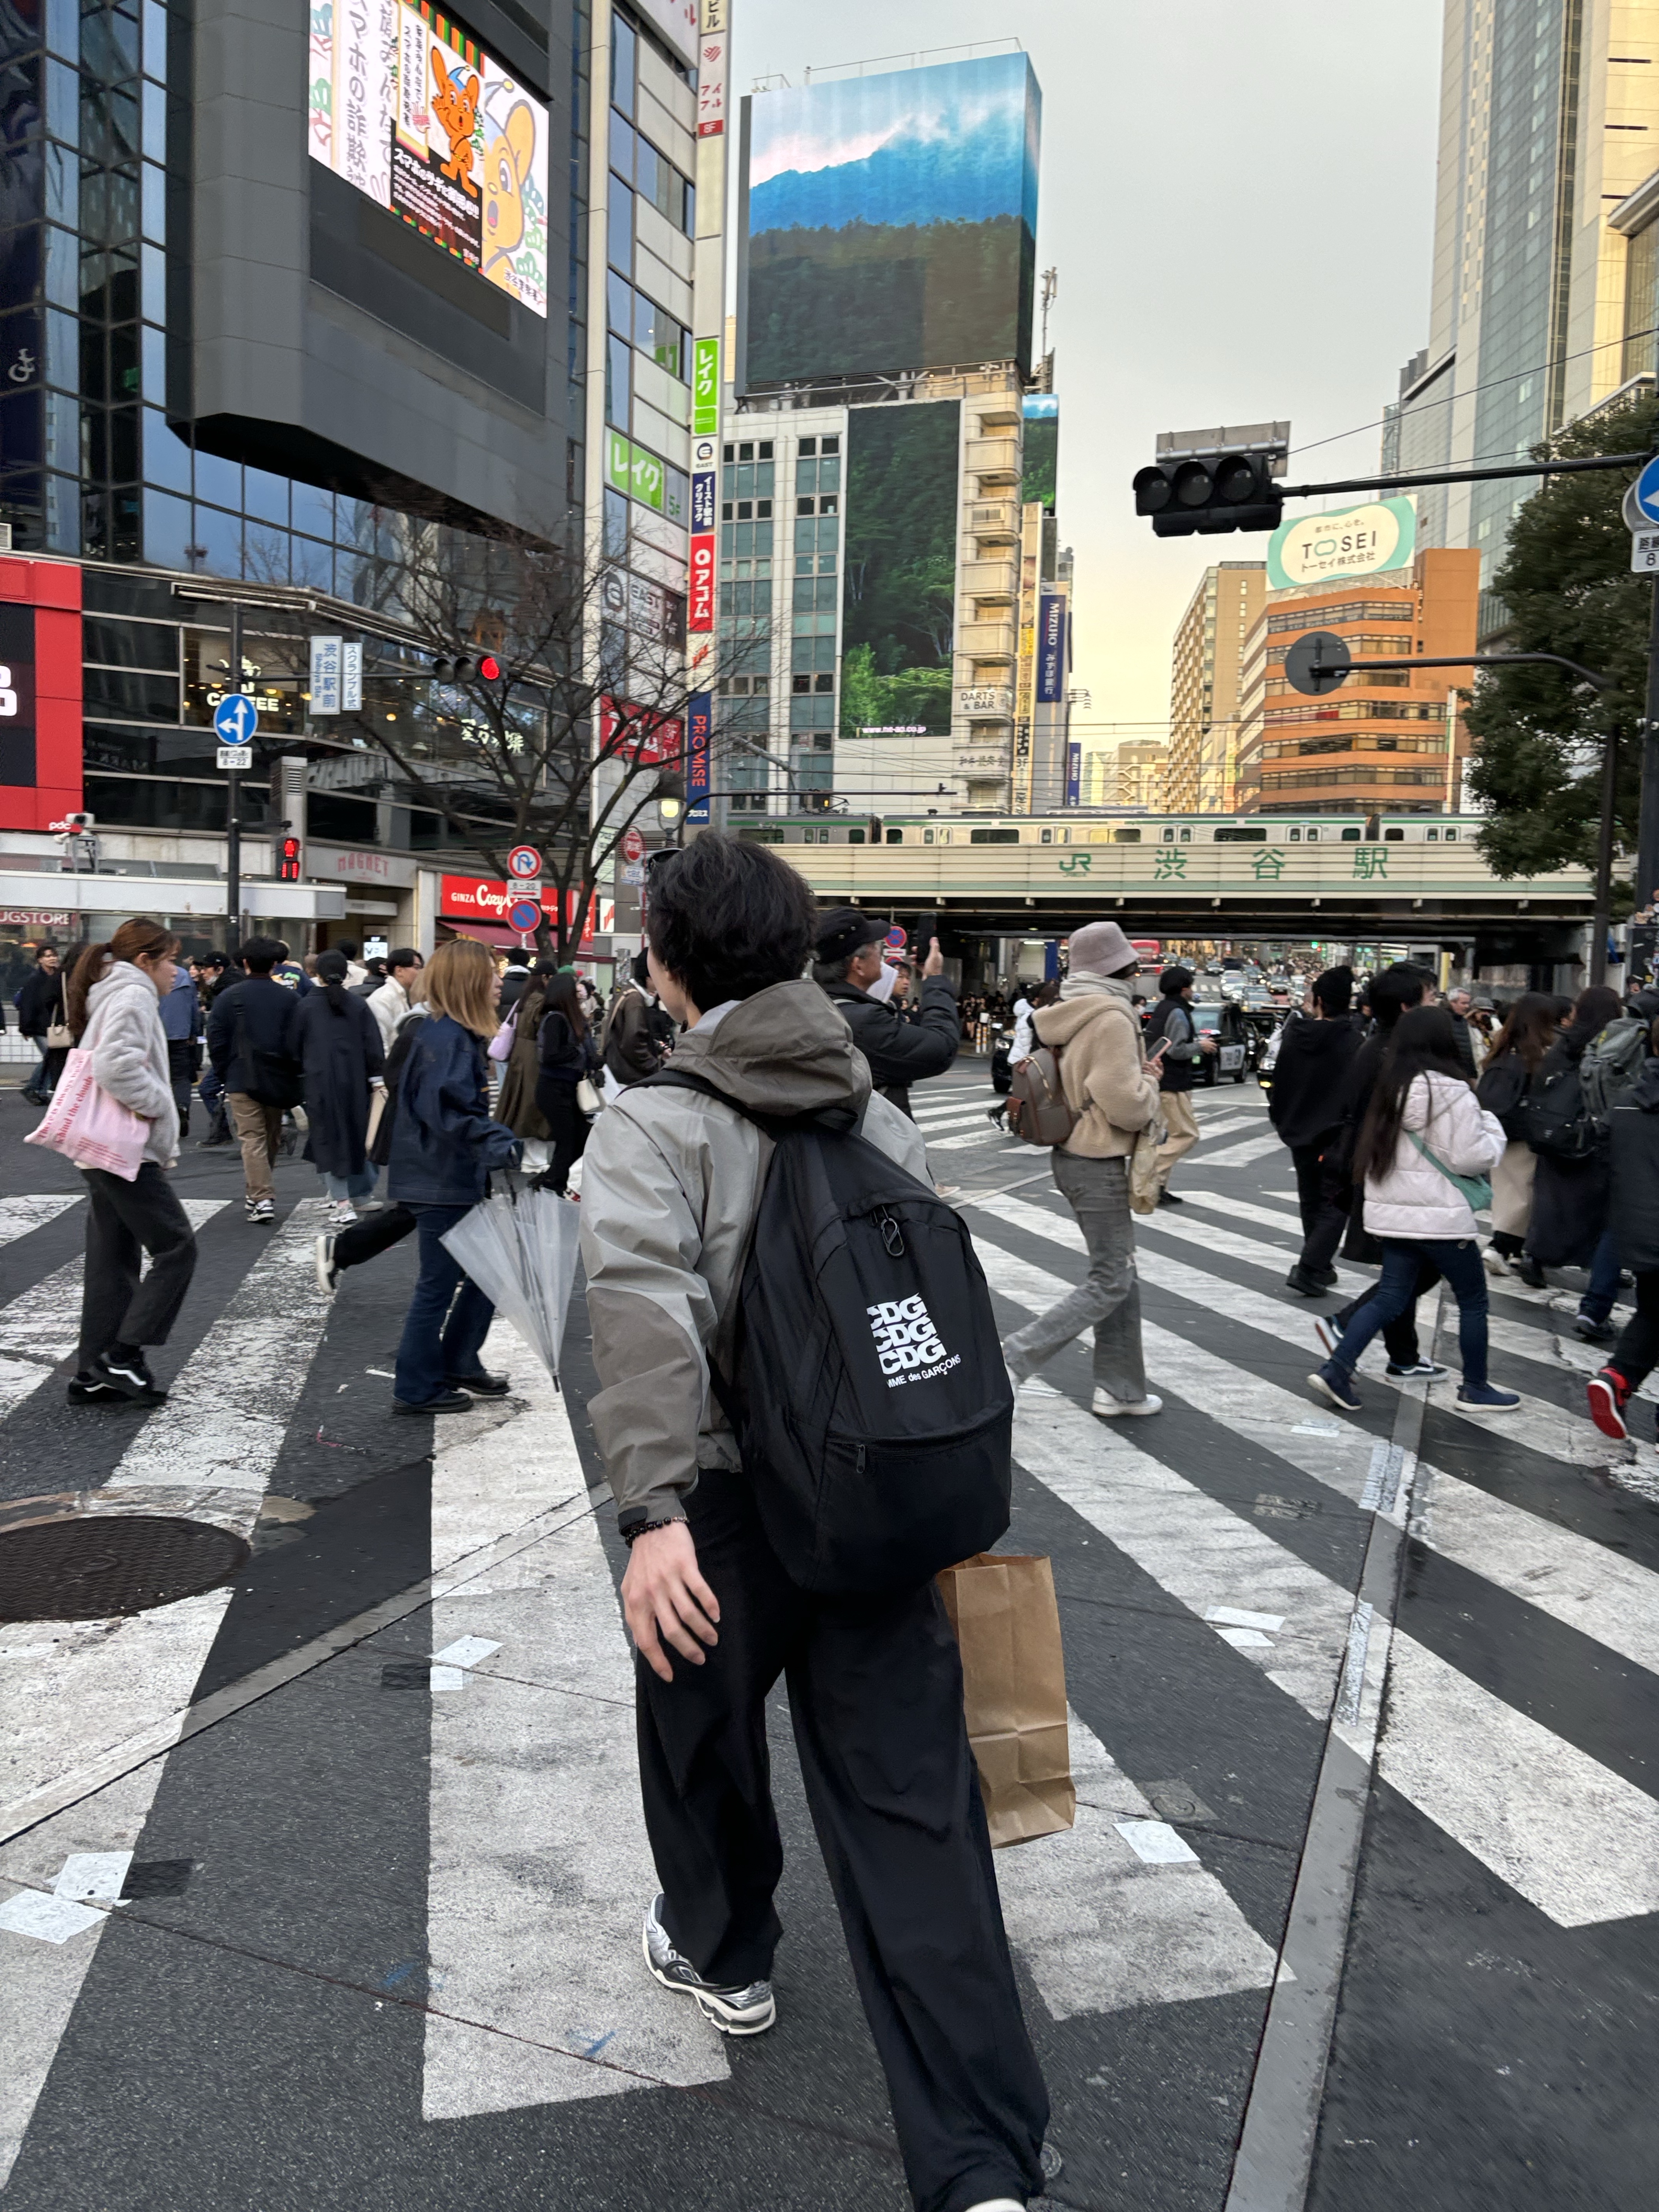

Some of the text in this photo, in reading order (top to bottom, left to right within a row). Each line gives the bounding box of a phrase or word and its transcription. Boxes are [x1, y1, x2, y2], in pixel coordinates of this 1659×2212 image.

[697, 349, 713, 396] レイク
[615, 443, 659, 492] レイク
[694, 483, 703, 522] クリニック
[1302, 531, 1376, 559] TOSEI
[1301, 551, 1376, 572] トーセイ株式会社
[1048, 603, 1060, 646] MIZUHO
[206, 692, 279, 712] CEE
[960, 691, 995, 701] DARTS
[973, 701, 994, 709] BAR
[692, 715, 707, 787] PROMISE
[1071, 752, 1079, 781] MIZUHO
[49, 821, 72, 831] pdc
[1059, 854, 1091, 872] JR
[451, 892, 476, 904] GINZA
[878, 1334, 947, 1375] CDG
[908, 1373, 921, 1382] des
